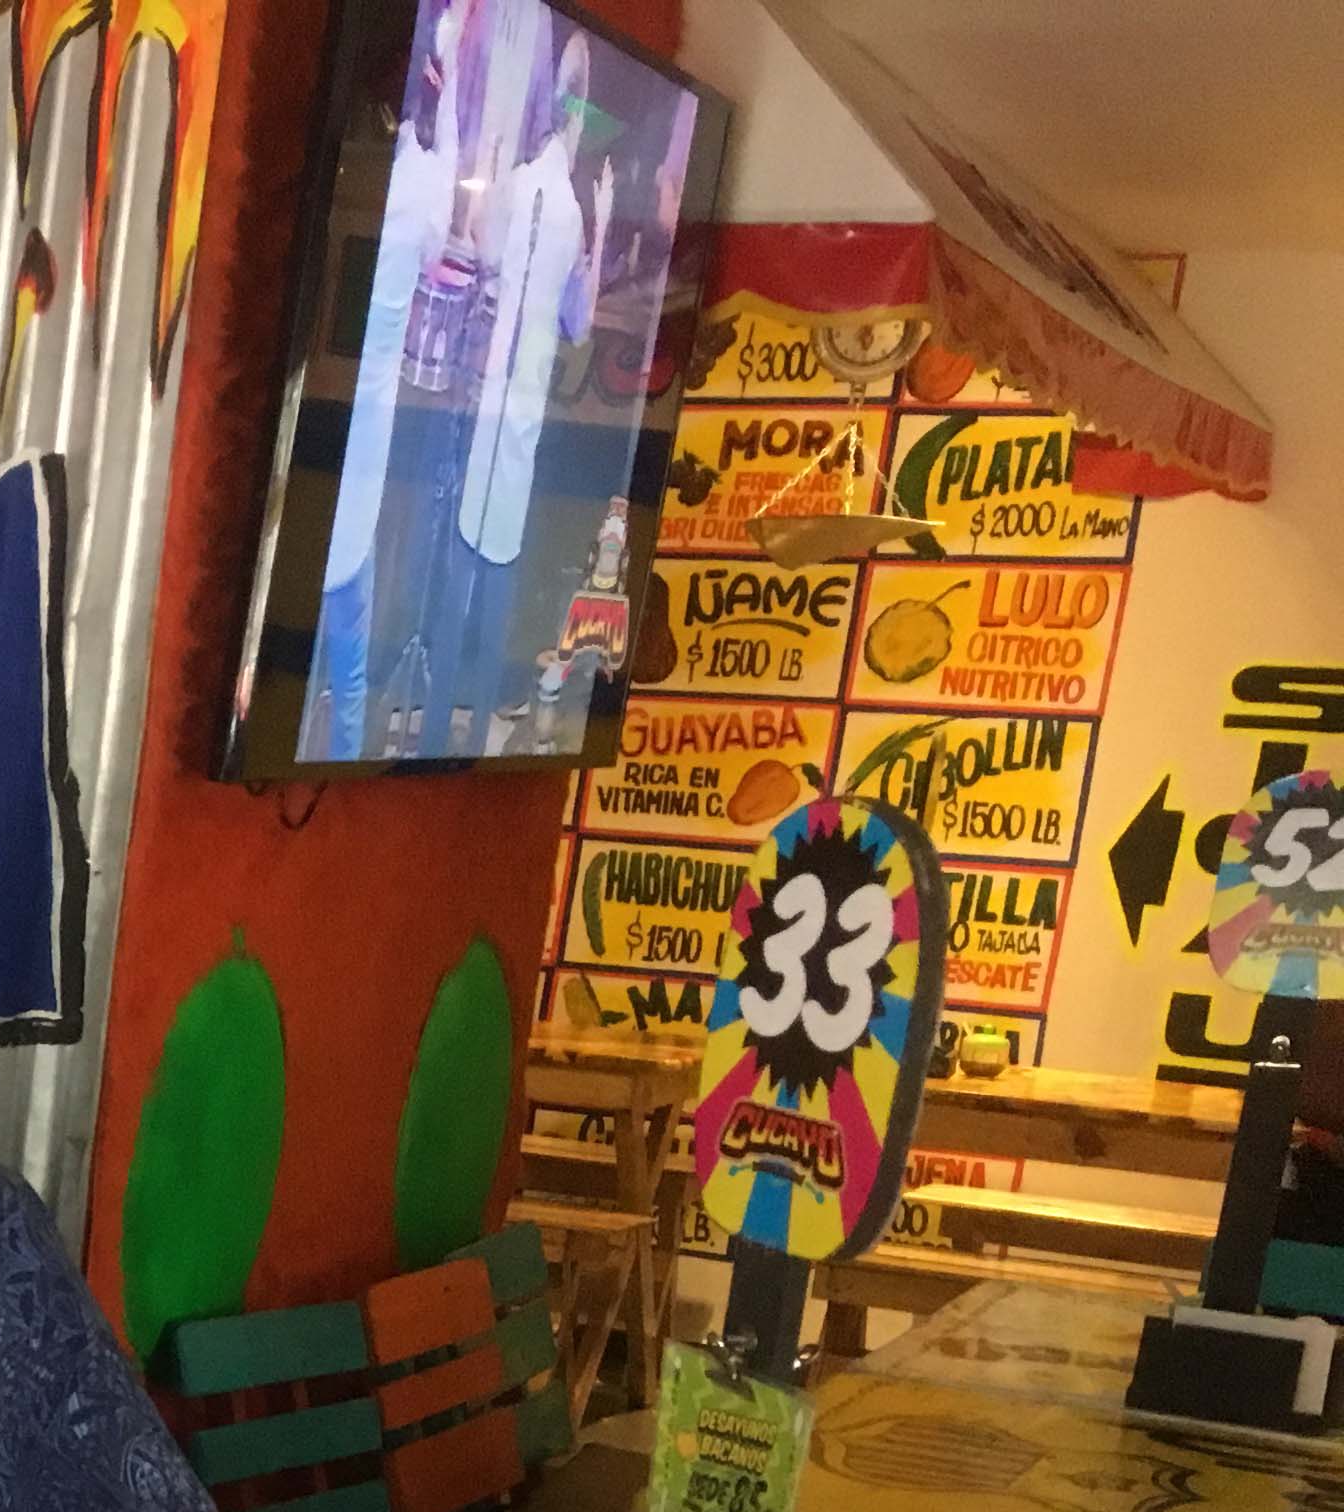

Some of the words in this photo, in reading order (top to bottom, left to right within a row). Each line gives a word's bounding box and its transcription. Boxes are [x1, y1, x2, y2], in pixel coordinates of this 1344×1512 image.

[719, 418, 864, 476] MORA
[937, 430, 1074, 505] PLATA
[684, 569, 851, 627] ÑAME
[979, 568, 1109, 630] LULO
[966, 632, 1084, 669] CITRICO
[939, 665, 1087, 705] NUTRITIVO
[620, 702, 808, 758] GUAYABA
[596, 784, 700, 818] VITAMINA
[624, 761, 679, 788] RICA
[689, 766, 721, 789] EN
[940, 871, 1060, 931] TILLA
[738, 872, 895, 1053] 33
[718, 1098, 846, 1190] CUCAYO
